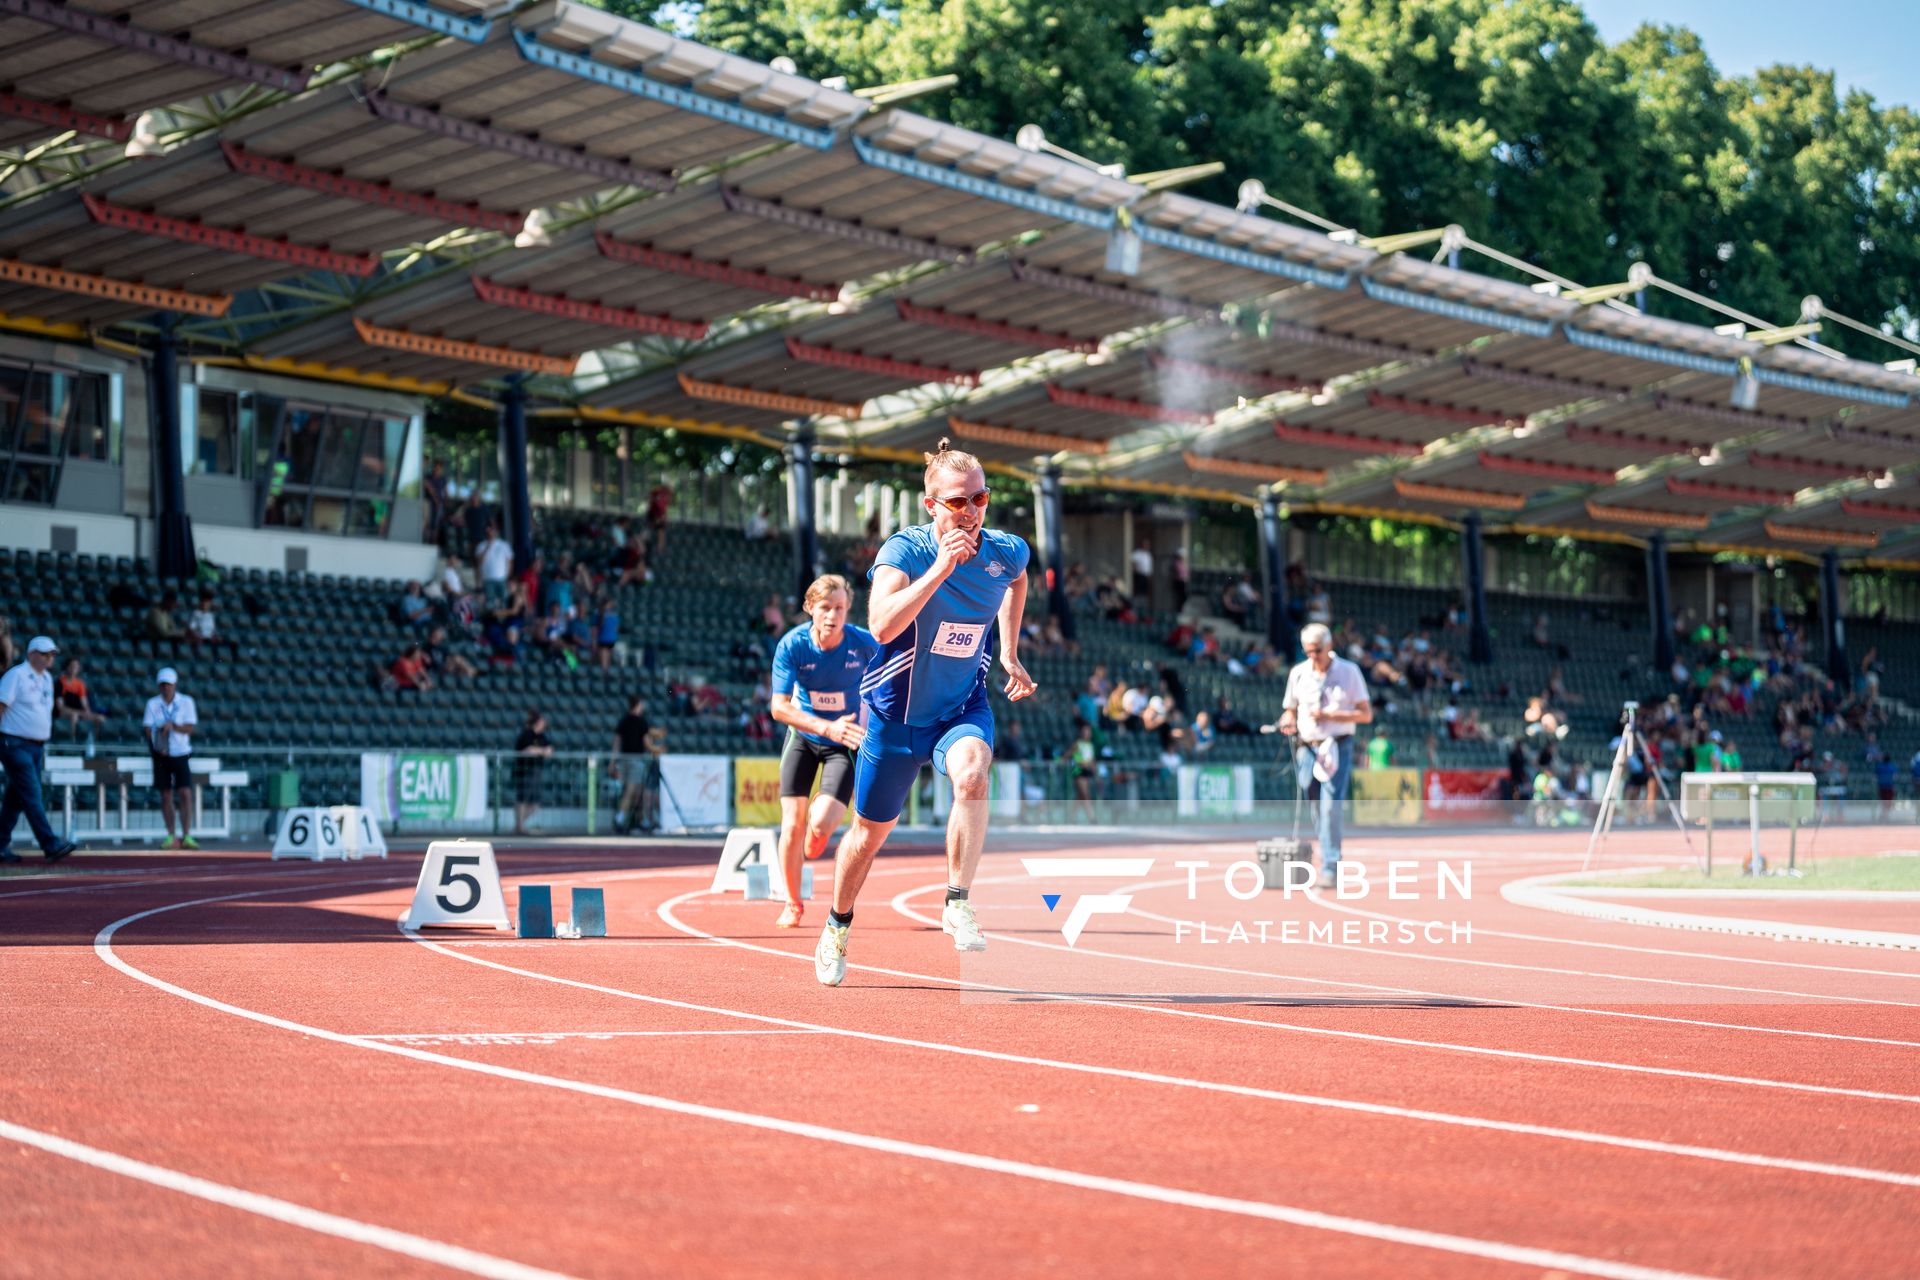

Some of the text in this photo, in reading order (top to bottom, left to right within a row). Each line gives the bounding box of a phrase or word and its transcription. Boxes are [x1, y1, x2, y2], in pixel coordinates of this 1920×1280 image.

[945, 632, 974, 646] 296
[818, 696, 837, 705] 403
[401, 760, 450, 801] EAM
[288, 814, 310, 847] 6
[320, 815, 336, 846] 6
[360, 815, 373, 845] 1
[733, 842, 761, 872] 4
[435, 855, 482, 914] 5
